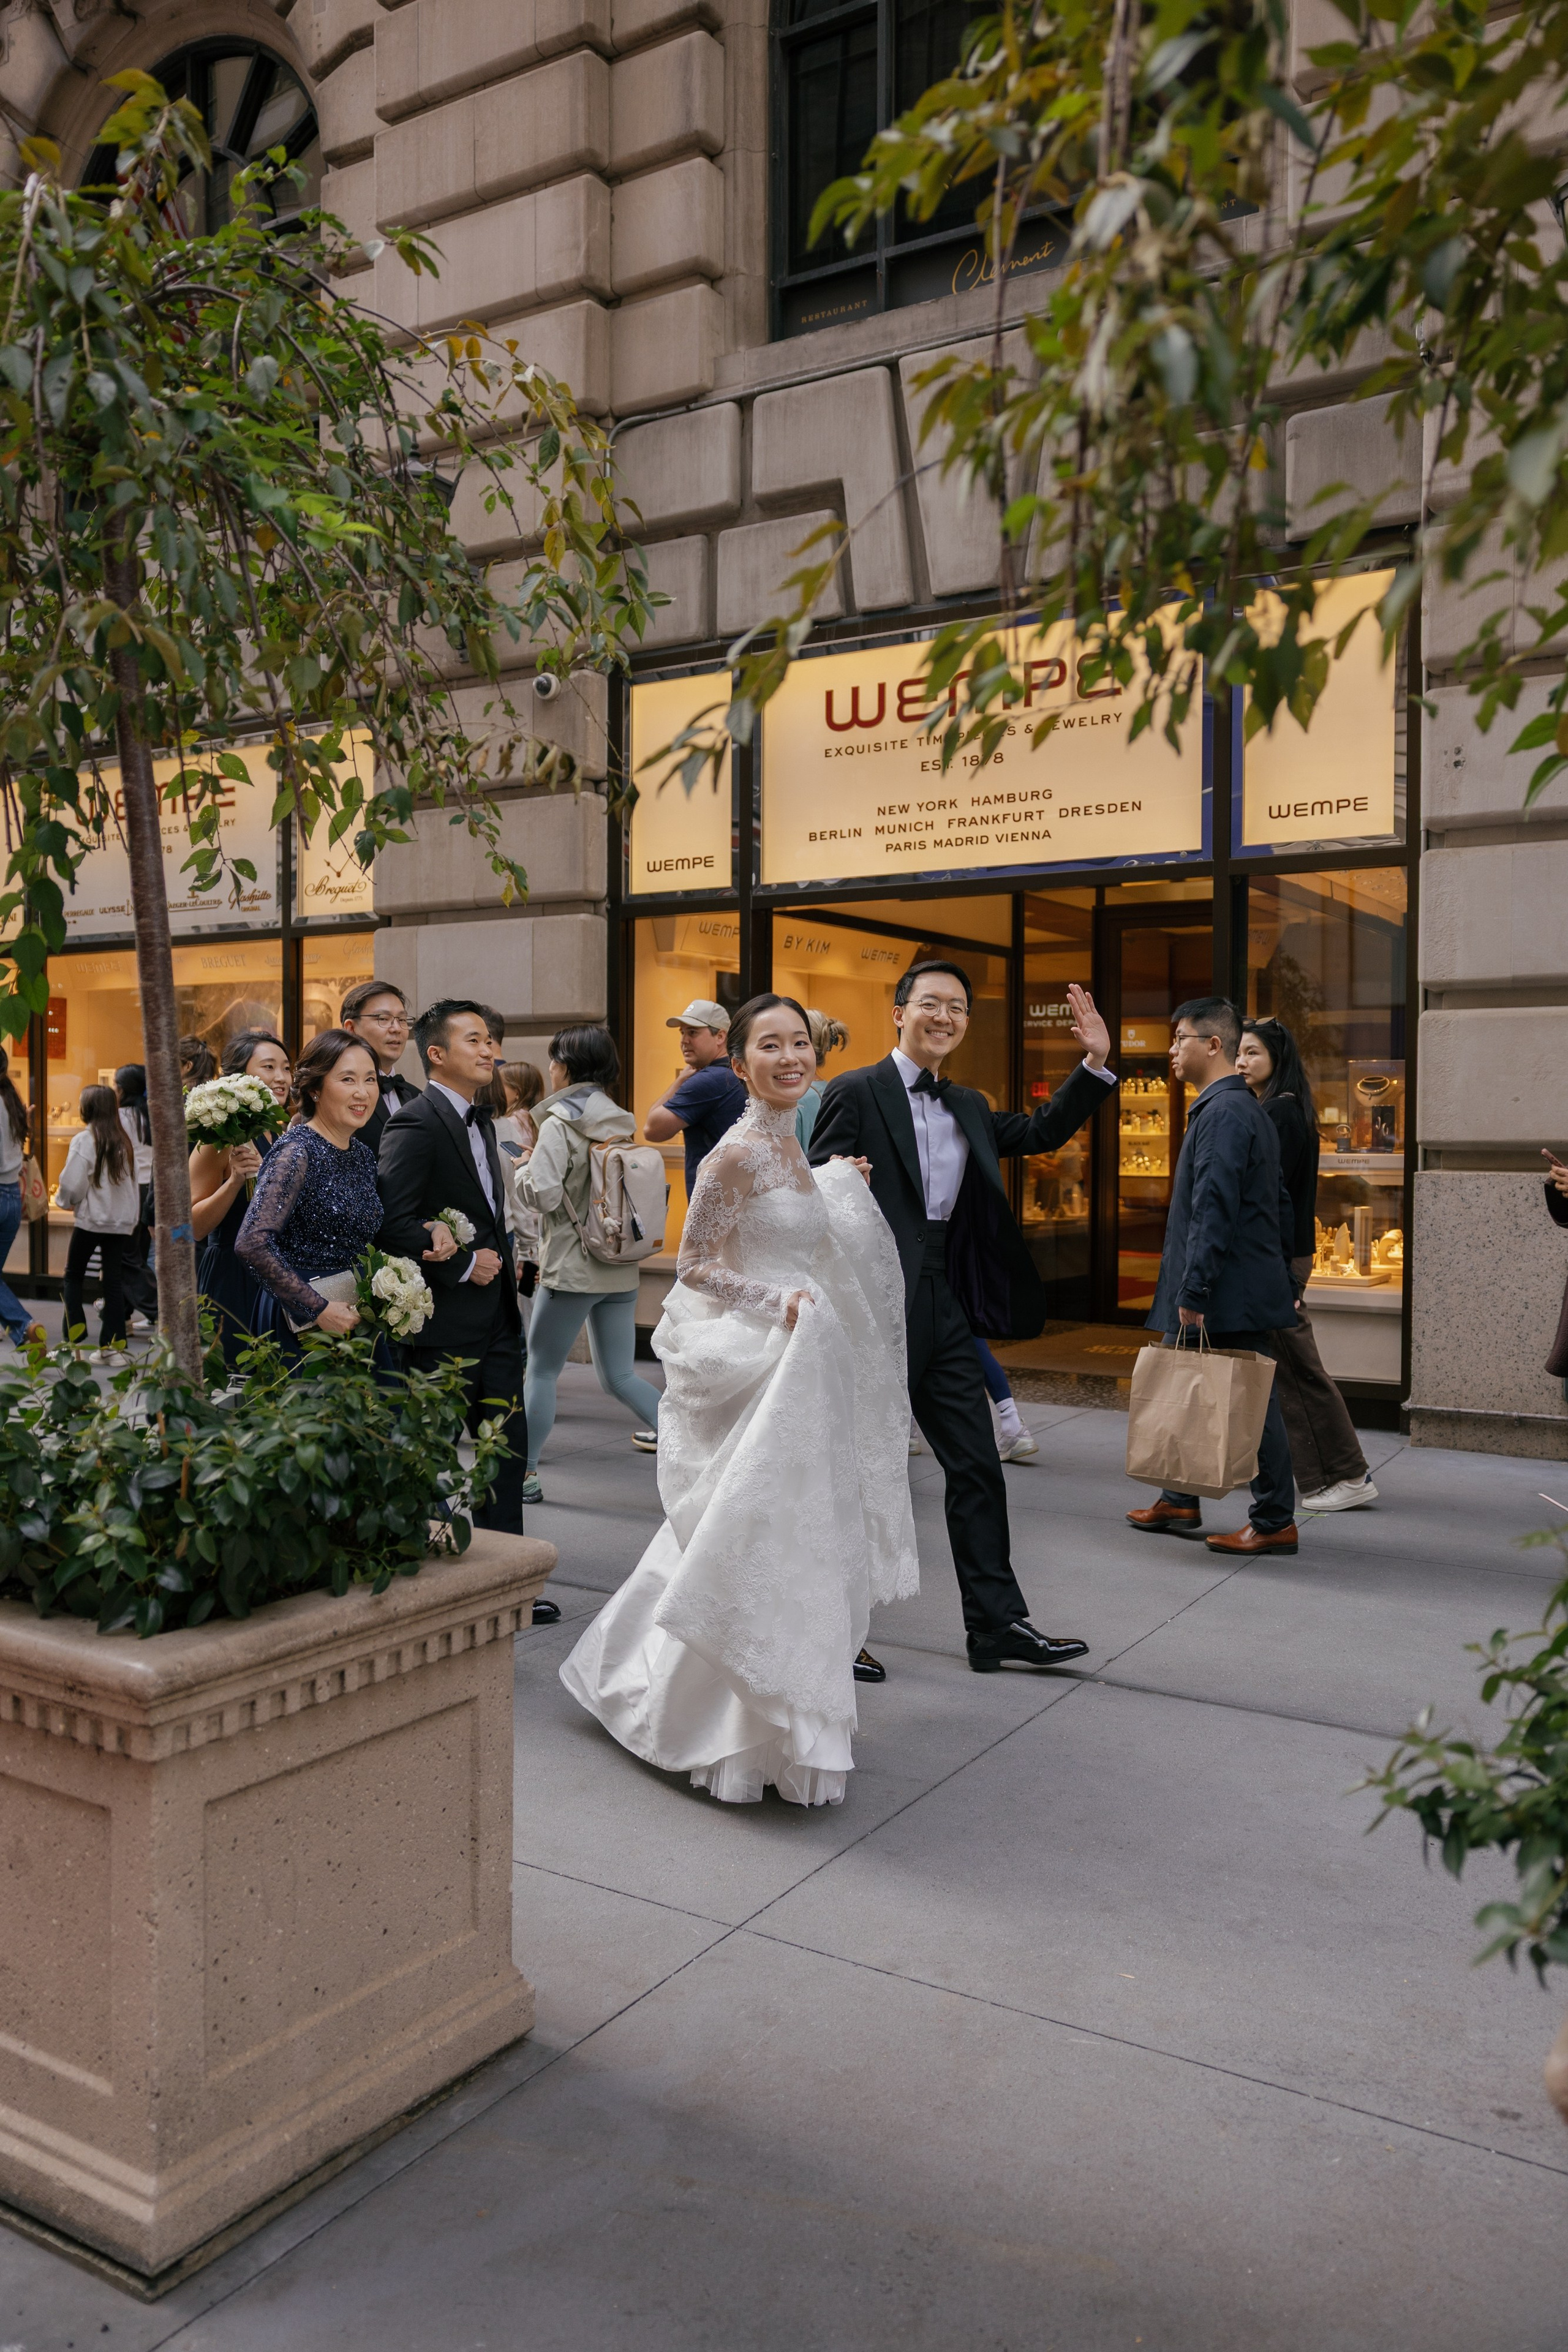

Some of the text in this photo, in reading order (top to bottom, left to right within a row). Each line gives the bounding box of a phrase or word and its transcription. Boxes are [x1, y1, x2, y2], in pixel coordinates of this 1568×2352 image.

[801, 300, 868, 323] RESTAURANT
[824, 739, 908, 758] EXQUISITE
[1024, 723, 1034, 734] &
[1052, 712, 1122, 731] EWELRY
[878, 790, 1053, 816] NEW YORK HAMBURG
[1268, 797, 1368, 819] WEMPE
[809, 801, 1142, 842] BERLIN MUNICH FRANKFURT DRESDEN
[886, 830, 1052, 853] PARIS MADRID VIENNA
[647, 856, 714, 872] WEMPE
[304, 875, 367, 903] Breguet
[99, 905, 126, 914] ULYSSE
[698, 921, 740, 938] WEMP
[783, 935, 831, 954] BY KIM
[200, 954, 246, 968] BREGUET
[861, 948, 901, 964] WEMPE
[1029, 1003, 1074, 1017] WEM
